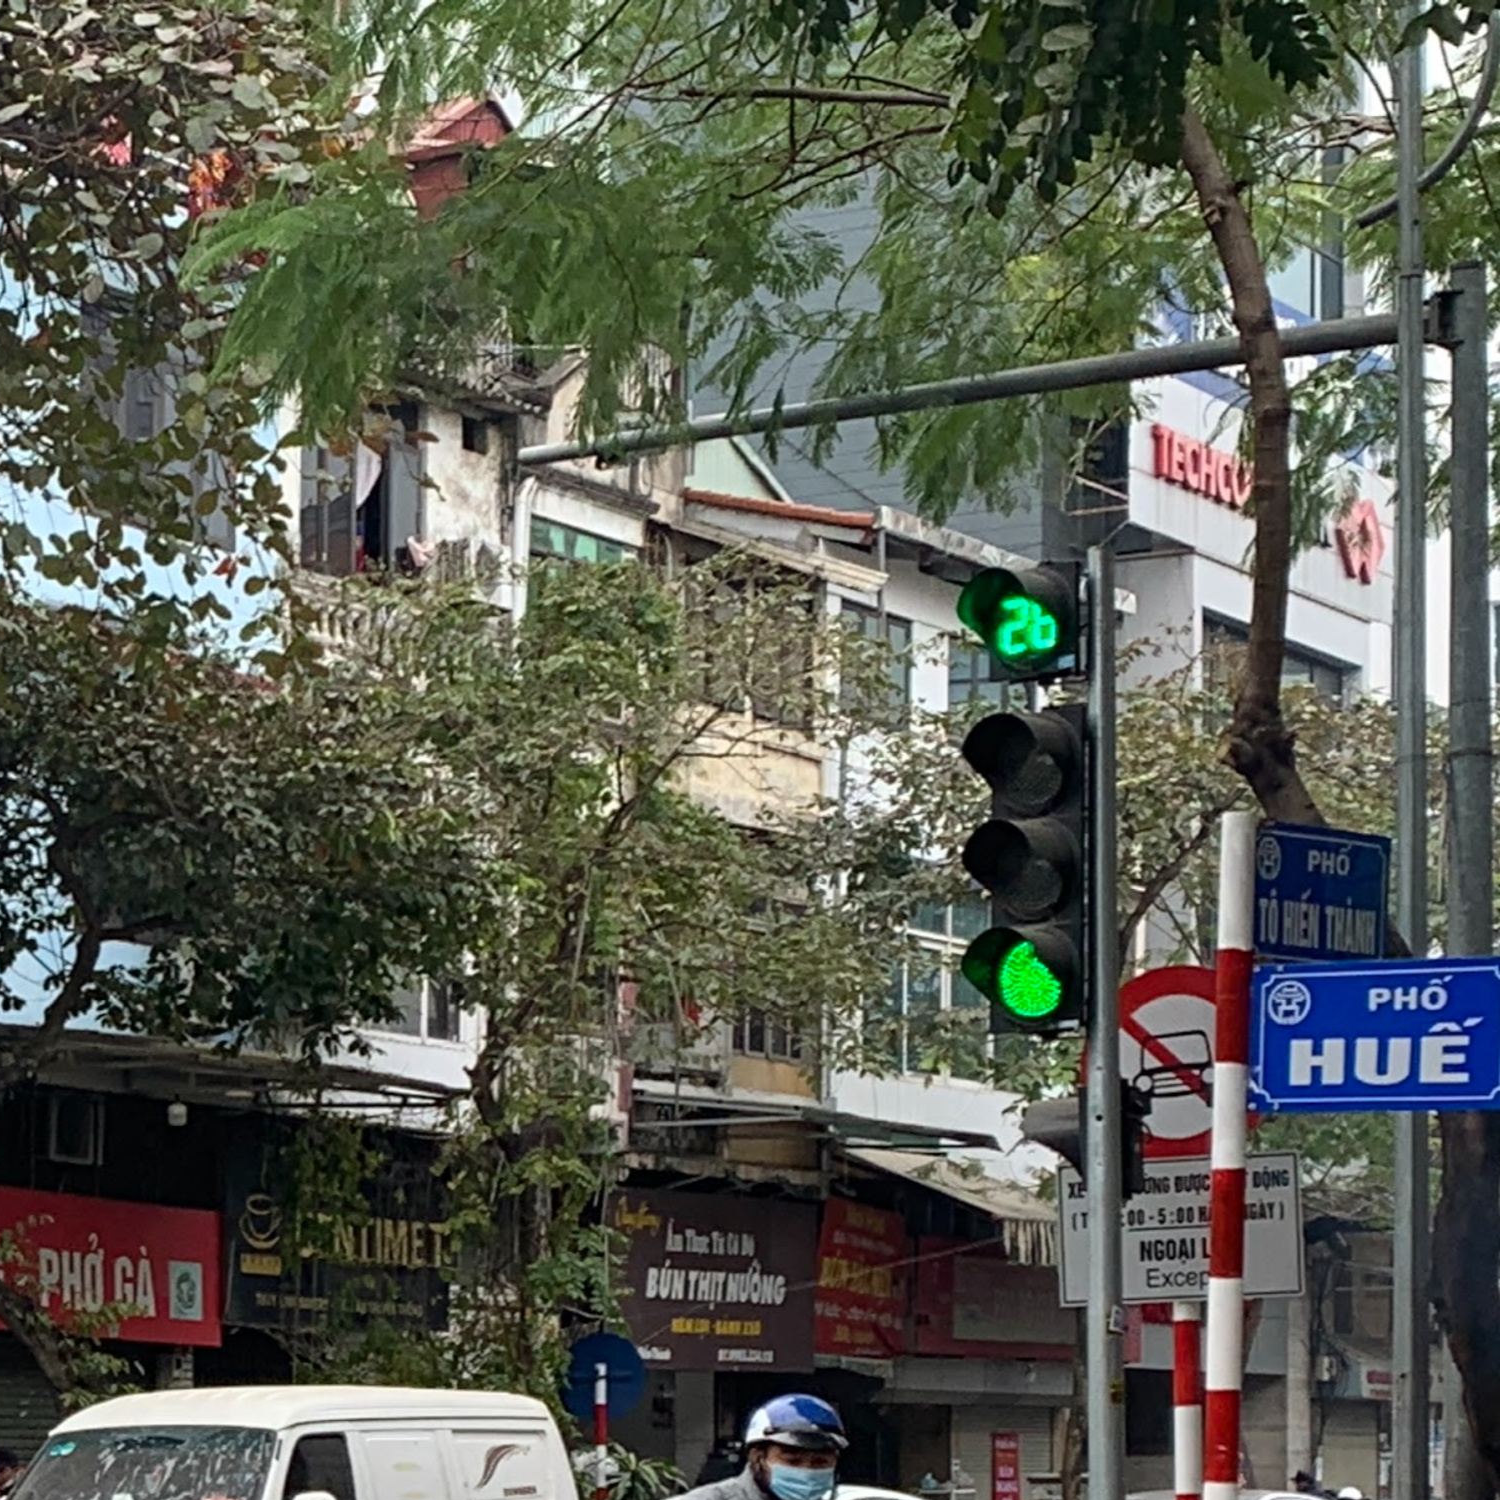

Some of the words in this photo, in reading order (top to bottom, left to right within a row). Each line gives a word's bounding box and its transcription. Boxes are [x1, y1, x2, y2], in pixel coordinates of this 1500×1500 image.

[1000, 596, 1056, 655] 26
[1307, 846, 1352, 877] PHỐ
[1259, 888, 1279, 945] TÔ
[1282, 888, 1321, 950] HIẾN
[1325, 896, 1377, 956] THÀNH
[1368, 975, 1454, 1012] PHỐ
[1288, 1016, 1485, 1087] HUẾ
[1174, 1173, 1211, 1196] ĐƯỢC
[1252, 1165, 1290, 1192] ĐỘNG
[1139, 1238, 1197, 1265] NGOẠI
[38, 1232, 105, 1314] PHỞ
[114, 1246, 156, 1318] GÀ
[645, 1259, 686, 1300] BÚN
[688, 1271, 726, 1311] THỊT
[1146, 1266, 1211, 1289] Excep
